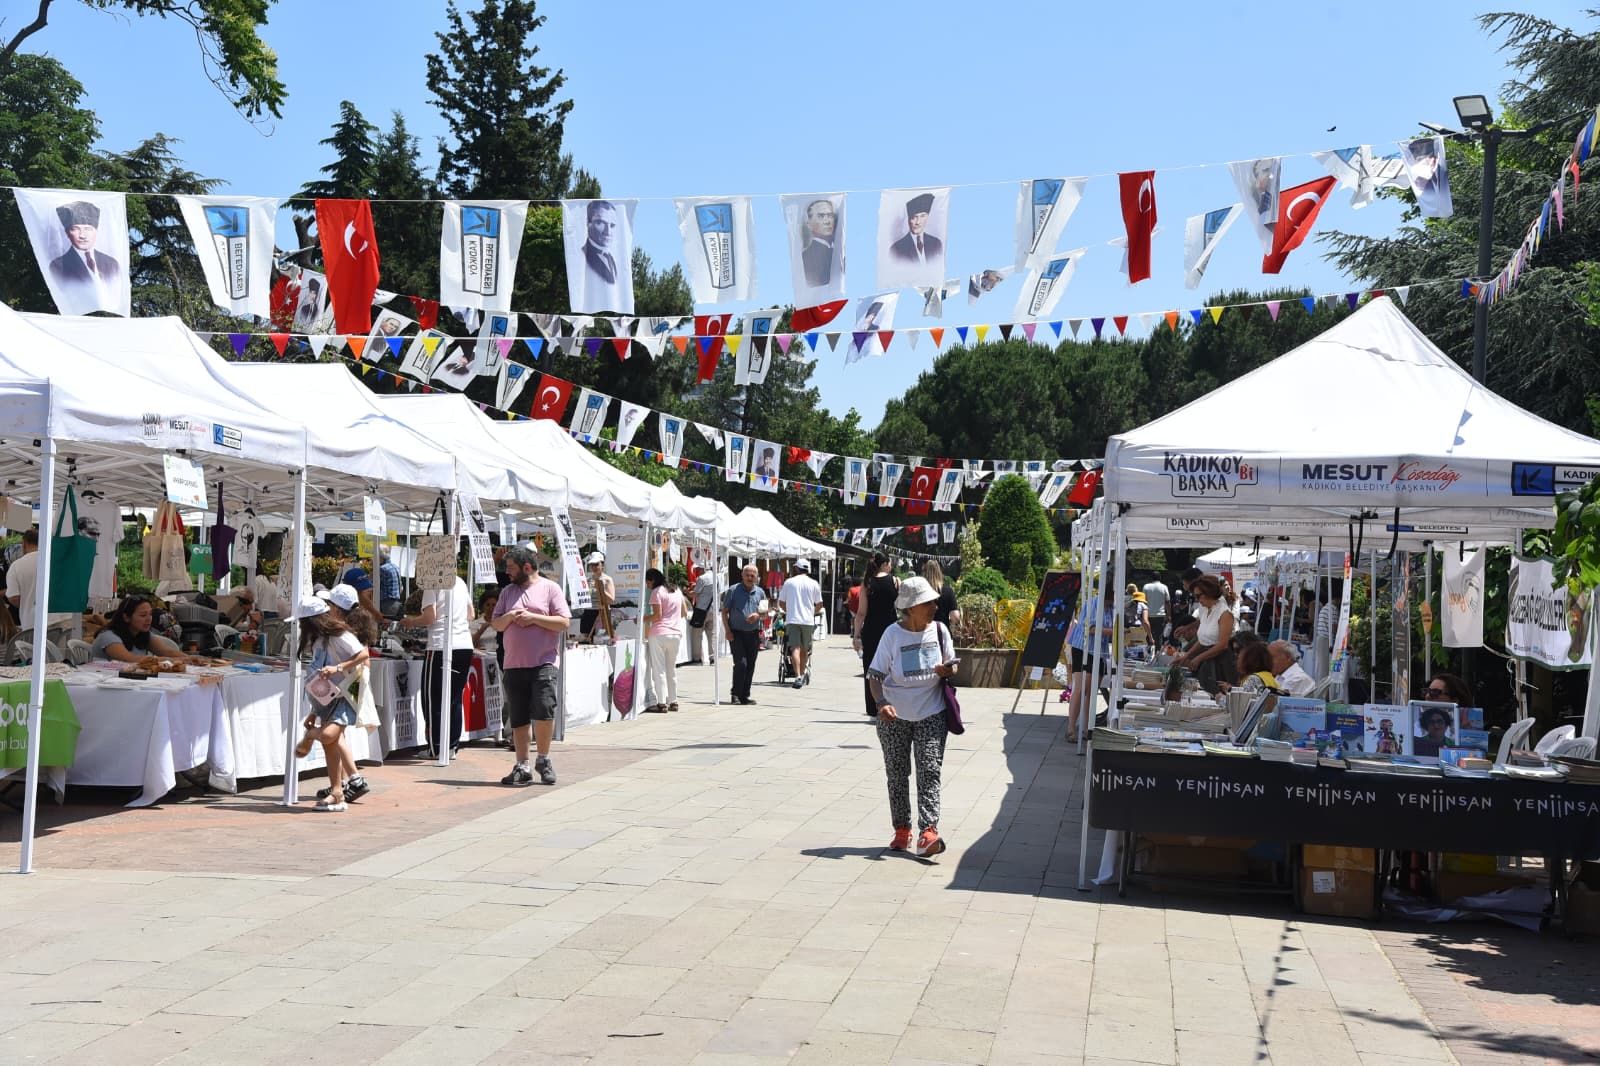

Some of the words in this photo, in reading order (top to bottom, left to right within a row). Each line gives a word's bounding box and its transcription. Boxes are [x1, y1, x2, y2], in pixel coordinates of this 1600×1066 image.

[1178, 474, 1230, 495] BAŞKA
[1302, 463, 1388, 481] MESUT
[1390, 461, 1464, 491] Kösedağı
[1302, 480, 1341, 490] KADIKÖY
[1345, 482, 1391, 492] BELEDİYE
